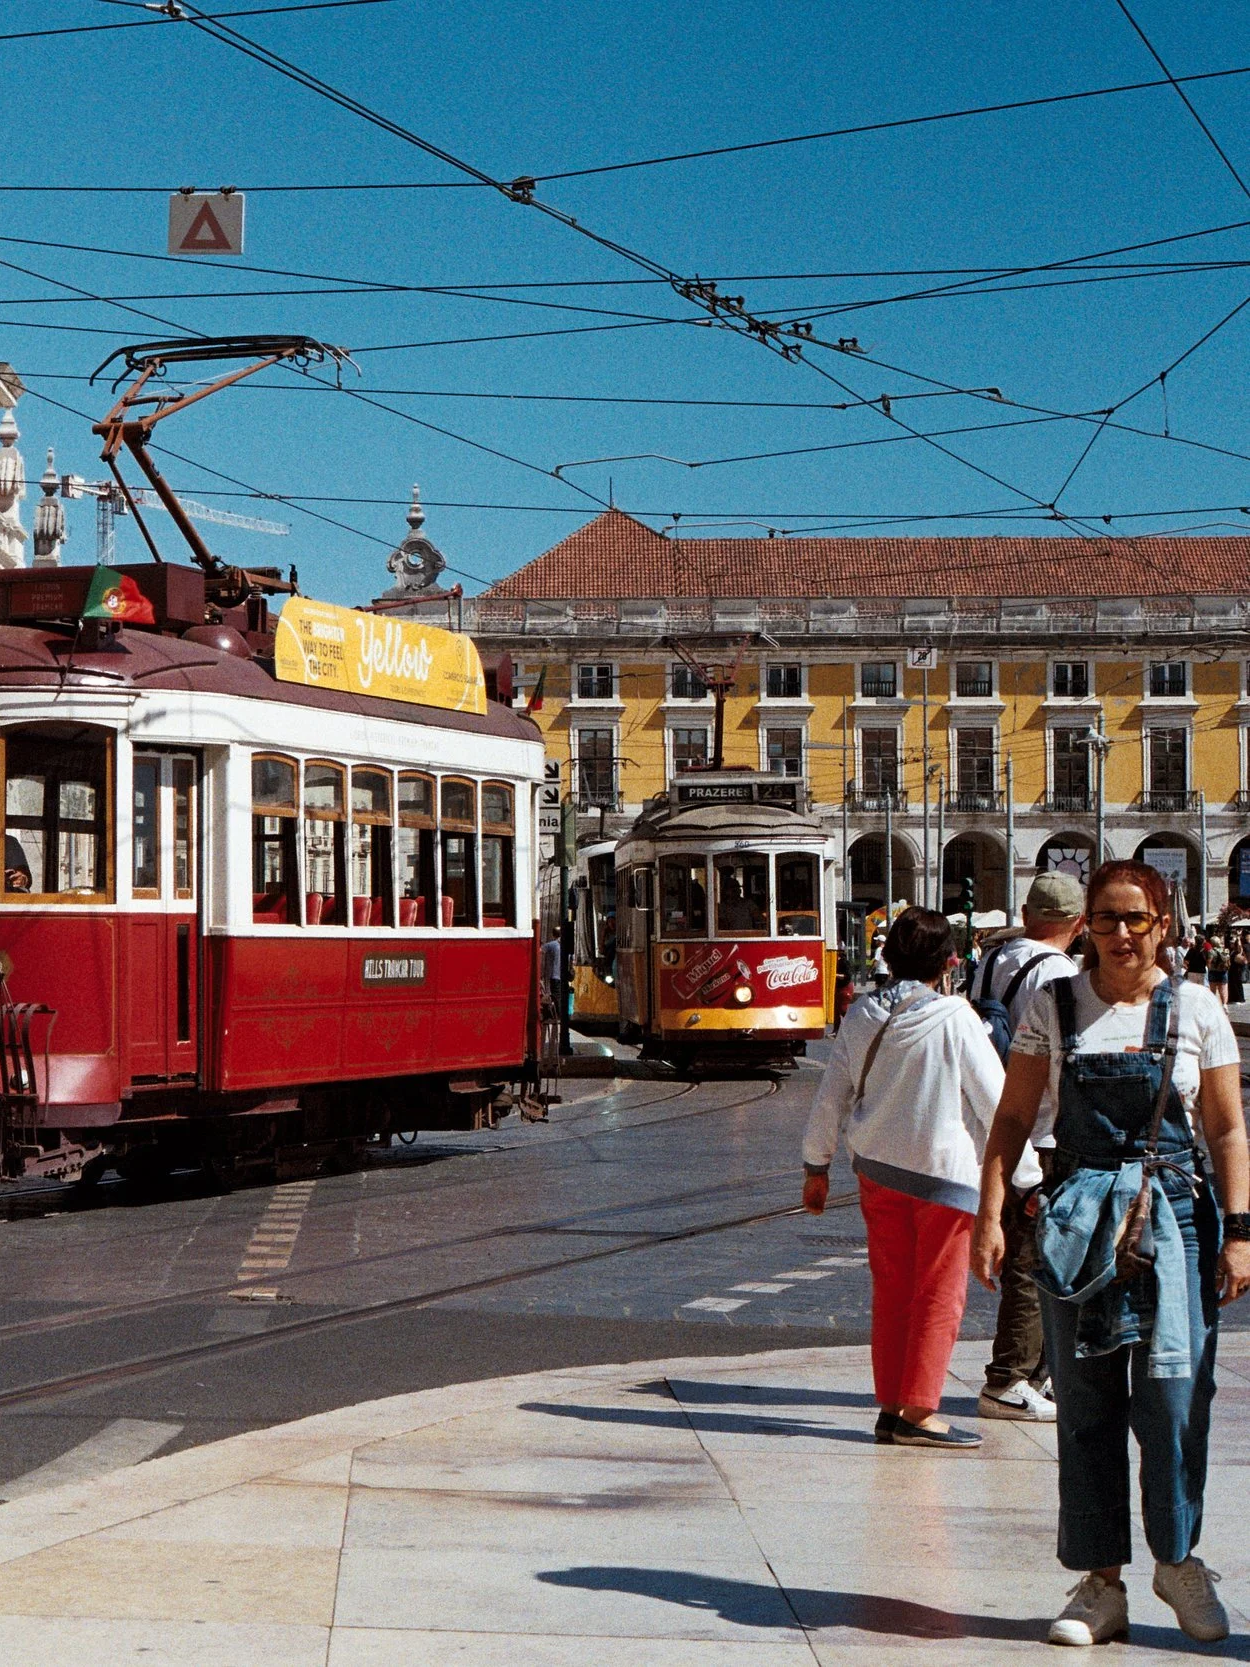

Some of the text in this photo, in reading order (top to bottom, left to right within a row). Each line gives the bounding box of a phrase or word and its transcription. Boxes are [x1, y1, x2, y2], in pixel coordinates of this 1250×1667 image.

[298, 619, 312, 636] THE
[302, 639, 344, 661] WAY TO FEEL
[355, 617, 433, 689] Yellow
[688, 787, 752, 799] PRAZERES
[364, 959, 383, 979] HILLS
[686, 948, 723, 984] Miguel
